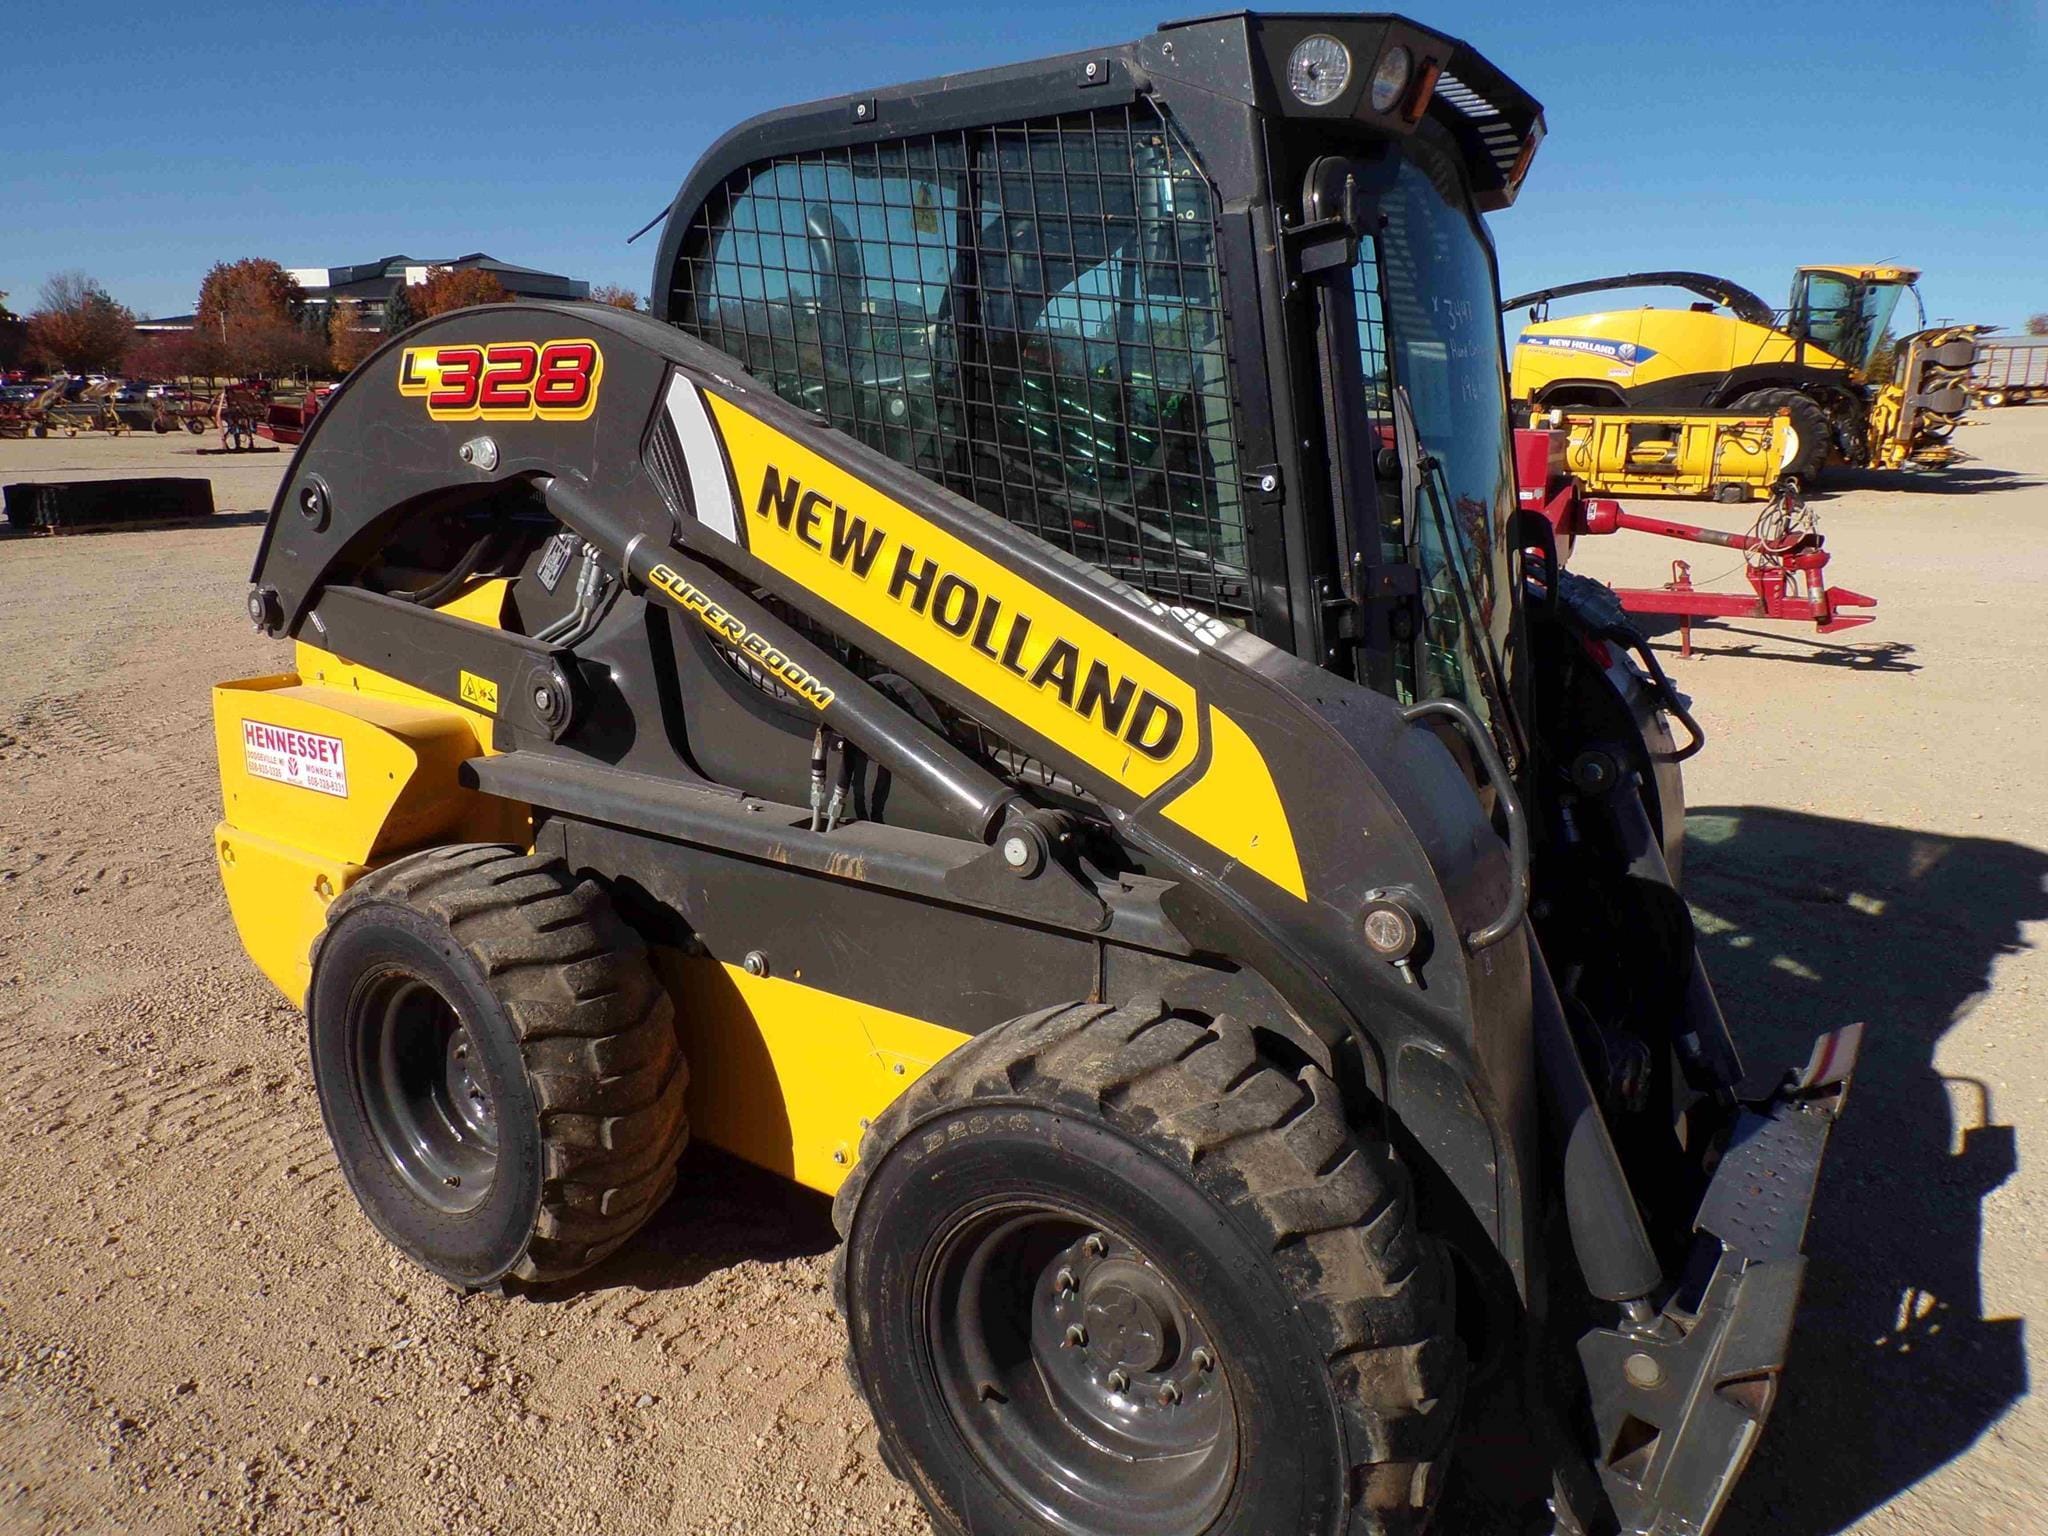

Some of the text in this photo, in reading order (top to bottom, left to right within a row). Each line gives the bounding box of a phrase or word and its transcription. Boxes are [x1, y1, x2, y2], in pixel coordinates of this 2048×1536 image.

[1548, 338, 1571, 347] NEW
[1571, 340, 1616, 355] HOLLAND
[756, 464, 1183, 761] NEW HOLLAND
[245, 724, 339, 764] HENNESSEY
